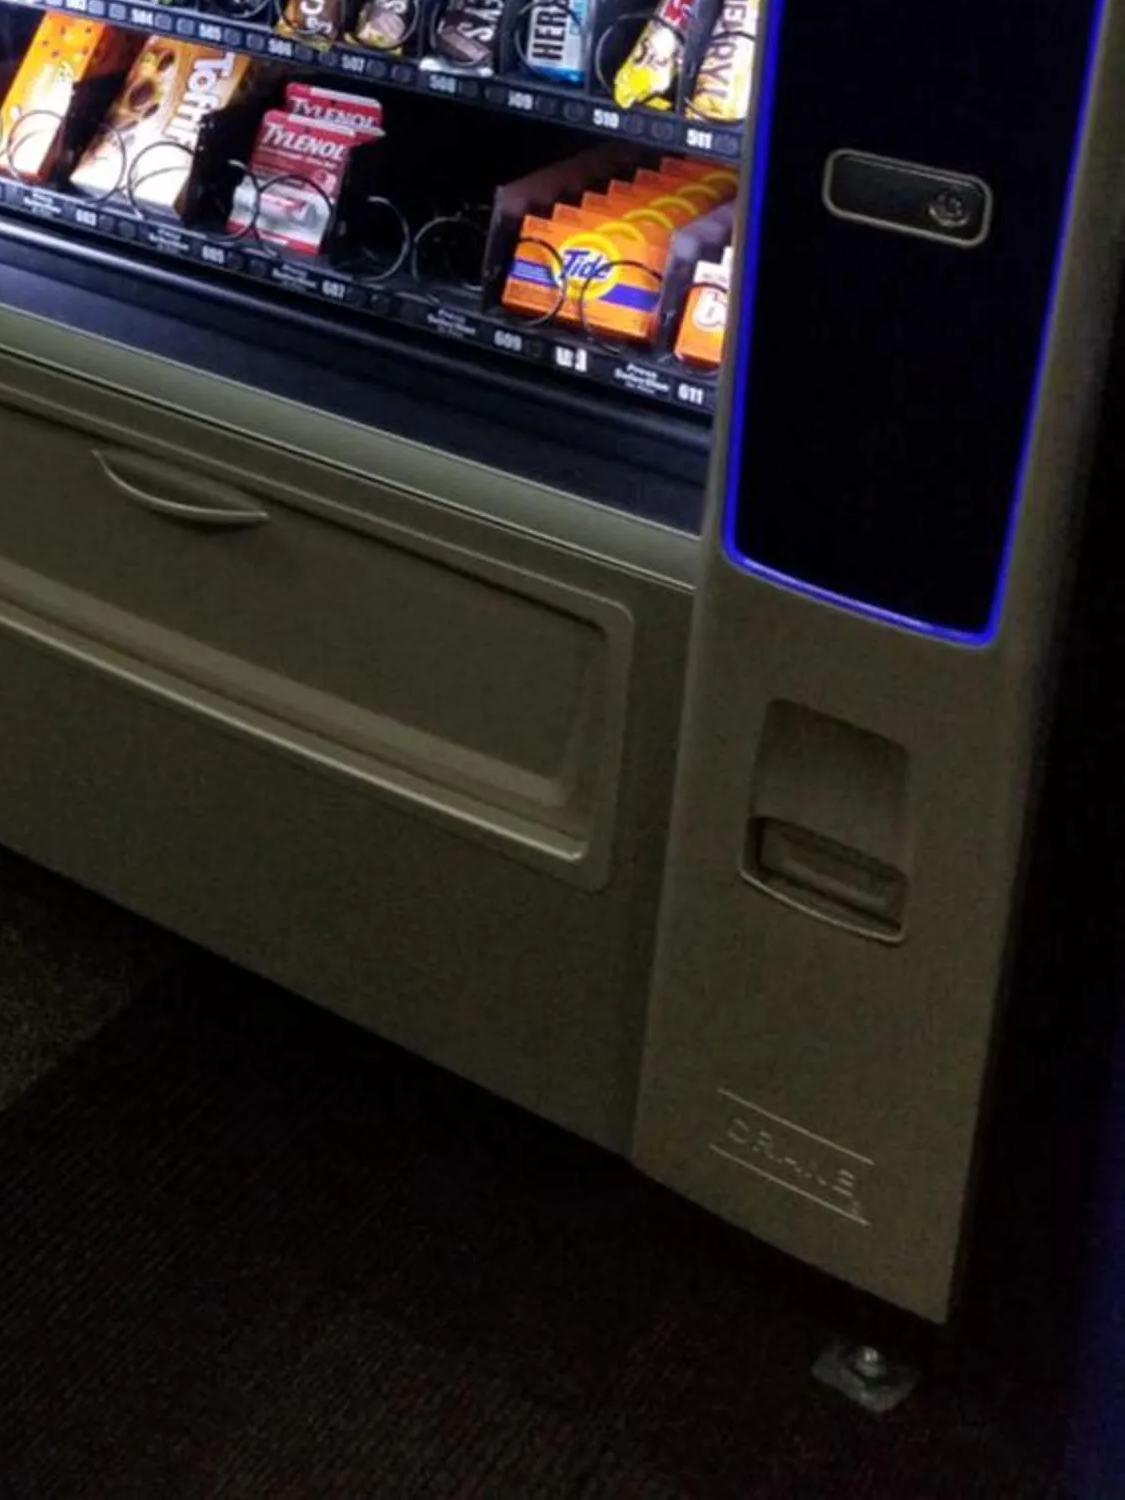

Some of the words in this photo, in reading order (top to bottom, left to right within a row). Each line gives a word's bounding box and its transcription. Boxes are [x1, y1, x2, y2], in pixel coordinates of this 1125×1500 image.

[262, 123, 346, 161] TYLENOL
[686, 129, 713, 149] 511
[561, 249, 613, 280] Tide
